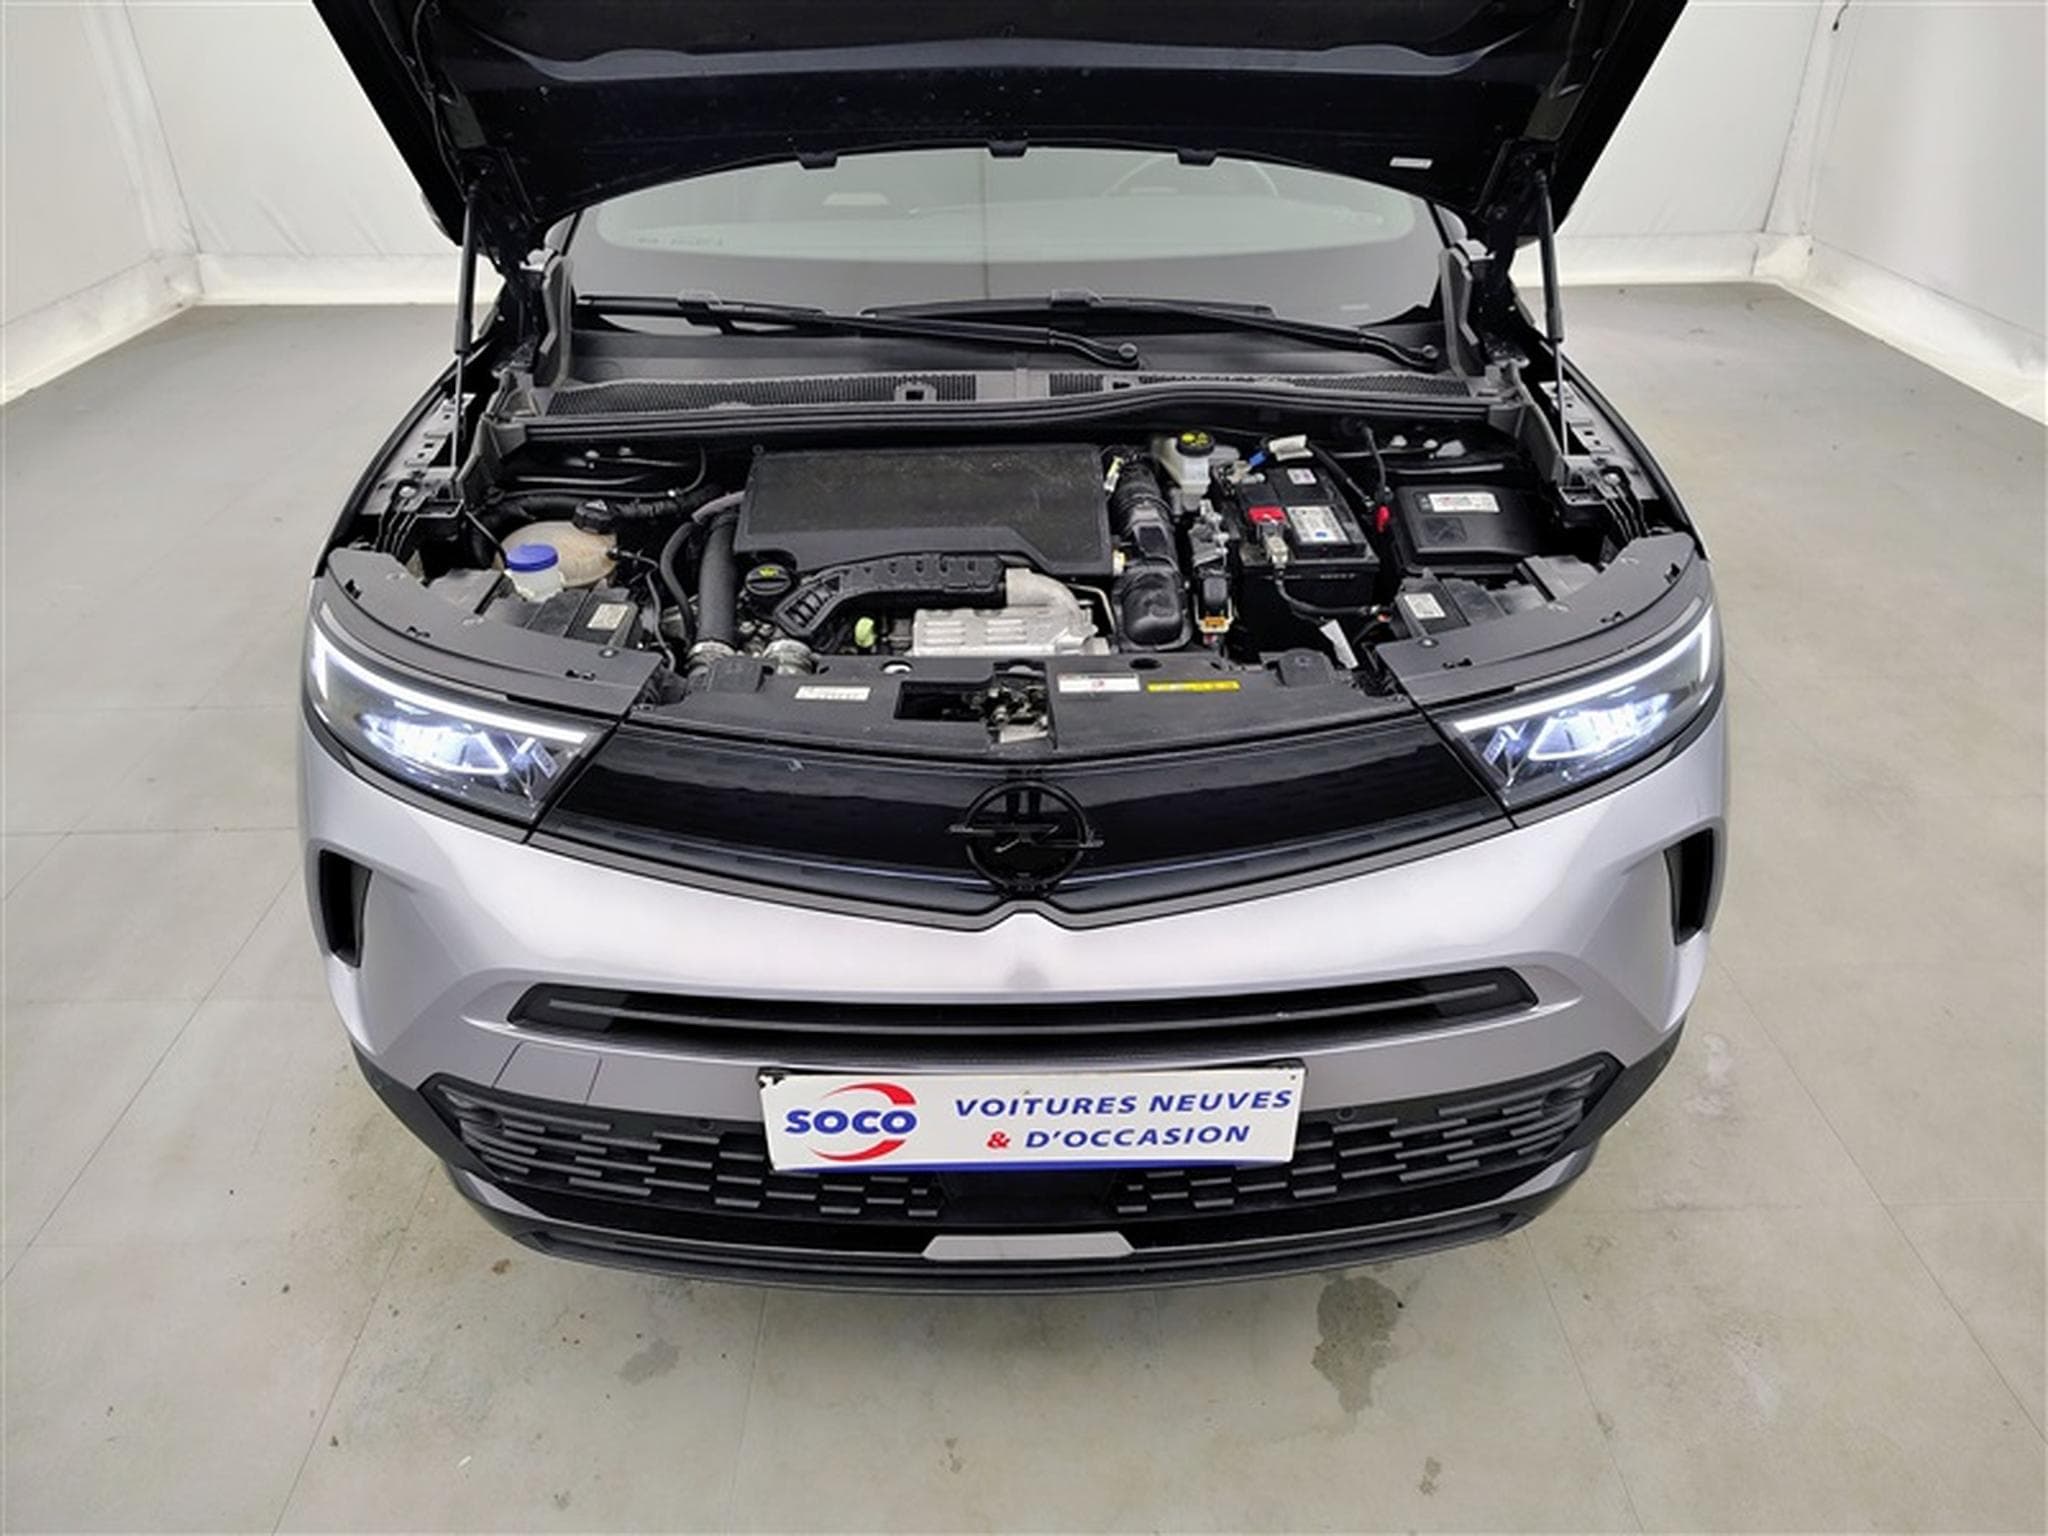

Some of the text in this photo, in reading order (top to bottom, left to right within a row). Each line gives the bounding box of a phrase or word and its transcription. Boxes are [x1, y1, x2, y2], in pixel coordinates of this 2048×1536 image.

[955, 1090, 1291, 1117] VOITURES NEUVES
[785, 1109, 918, 1136] SOCO
[986, 1125, 1249, 1150] & D'OCCASION
